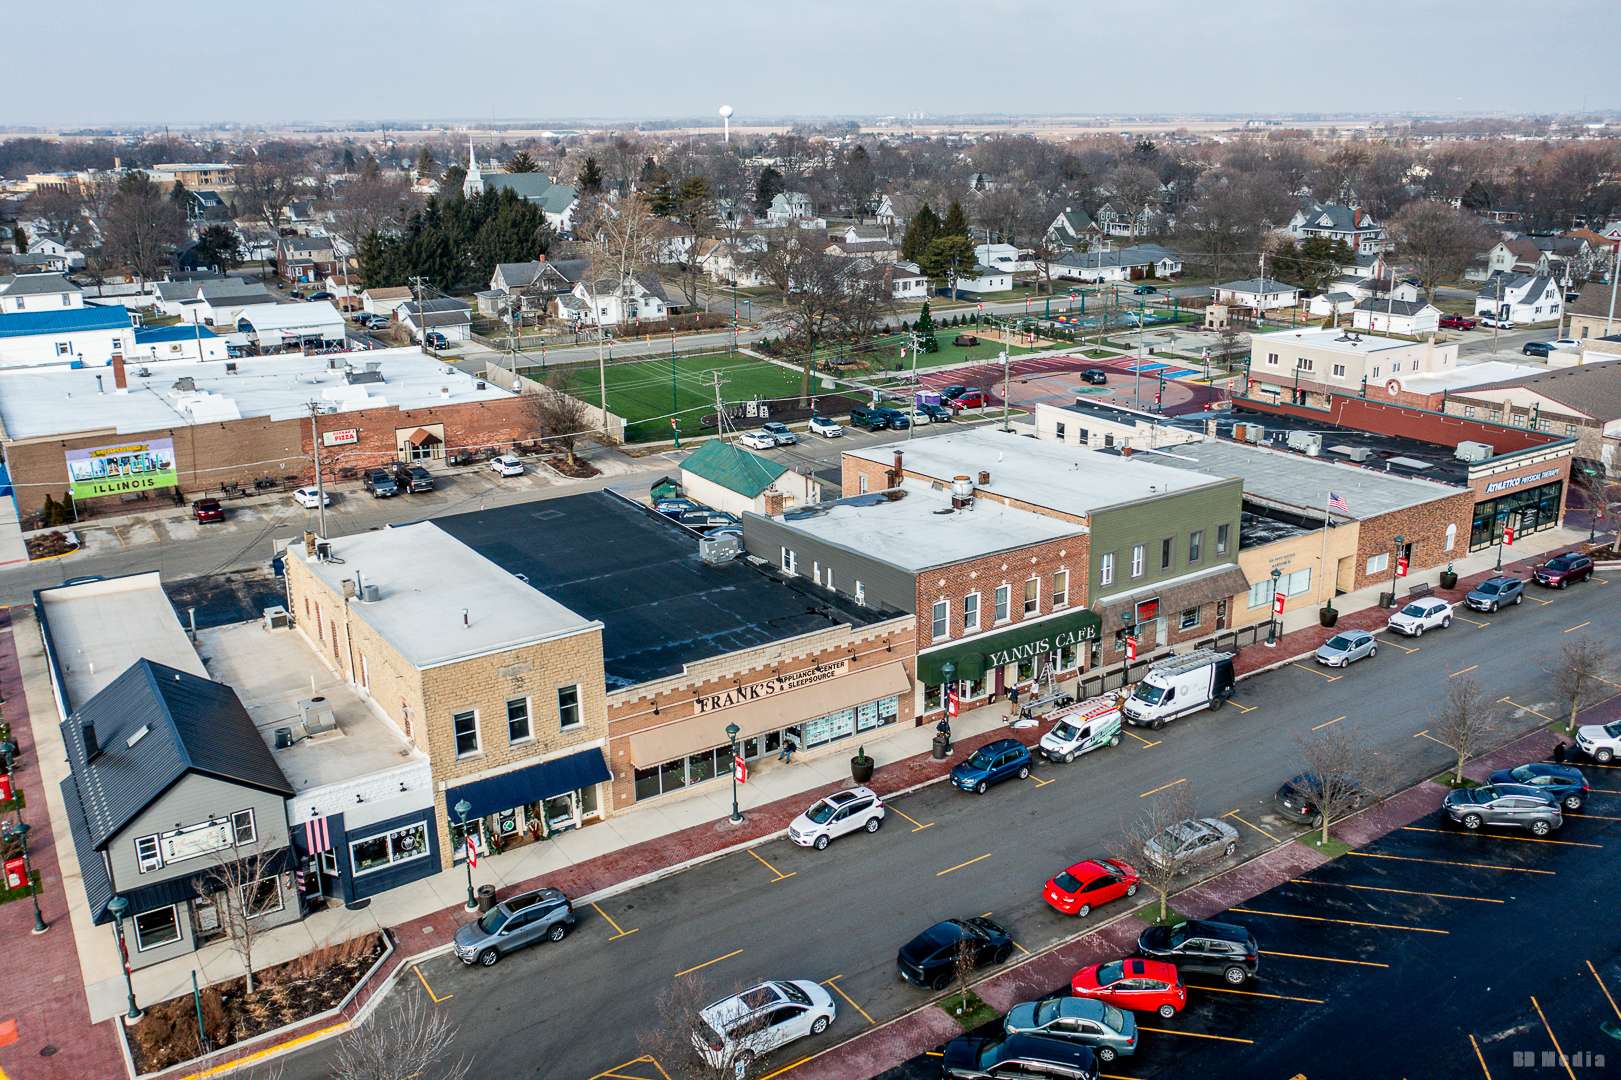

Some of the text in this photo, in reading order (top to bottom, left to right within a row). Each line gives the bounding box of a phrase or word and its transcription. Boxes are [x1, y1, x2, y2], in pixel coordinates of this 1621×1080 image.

[93, 478, 155, 494] ILLINOIS
[990, 638, 1050, 667] YANNIS
[779, 669, 816, 683] PPLIANCE
[788, 670, 835, 689] SLEEPSOURCE
[699, 680, 775, 713] FRANK'S
